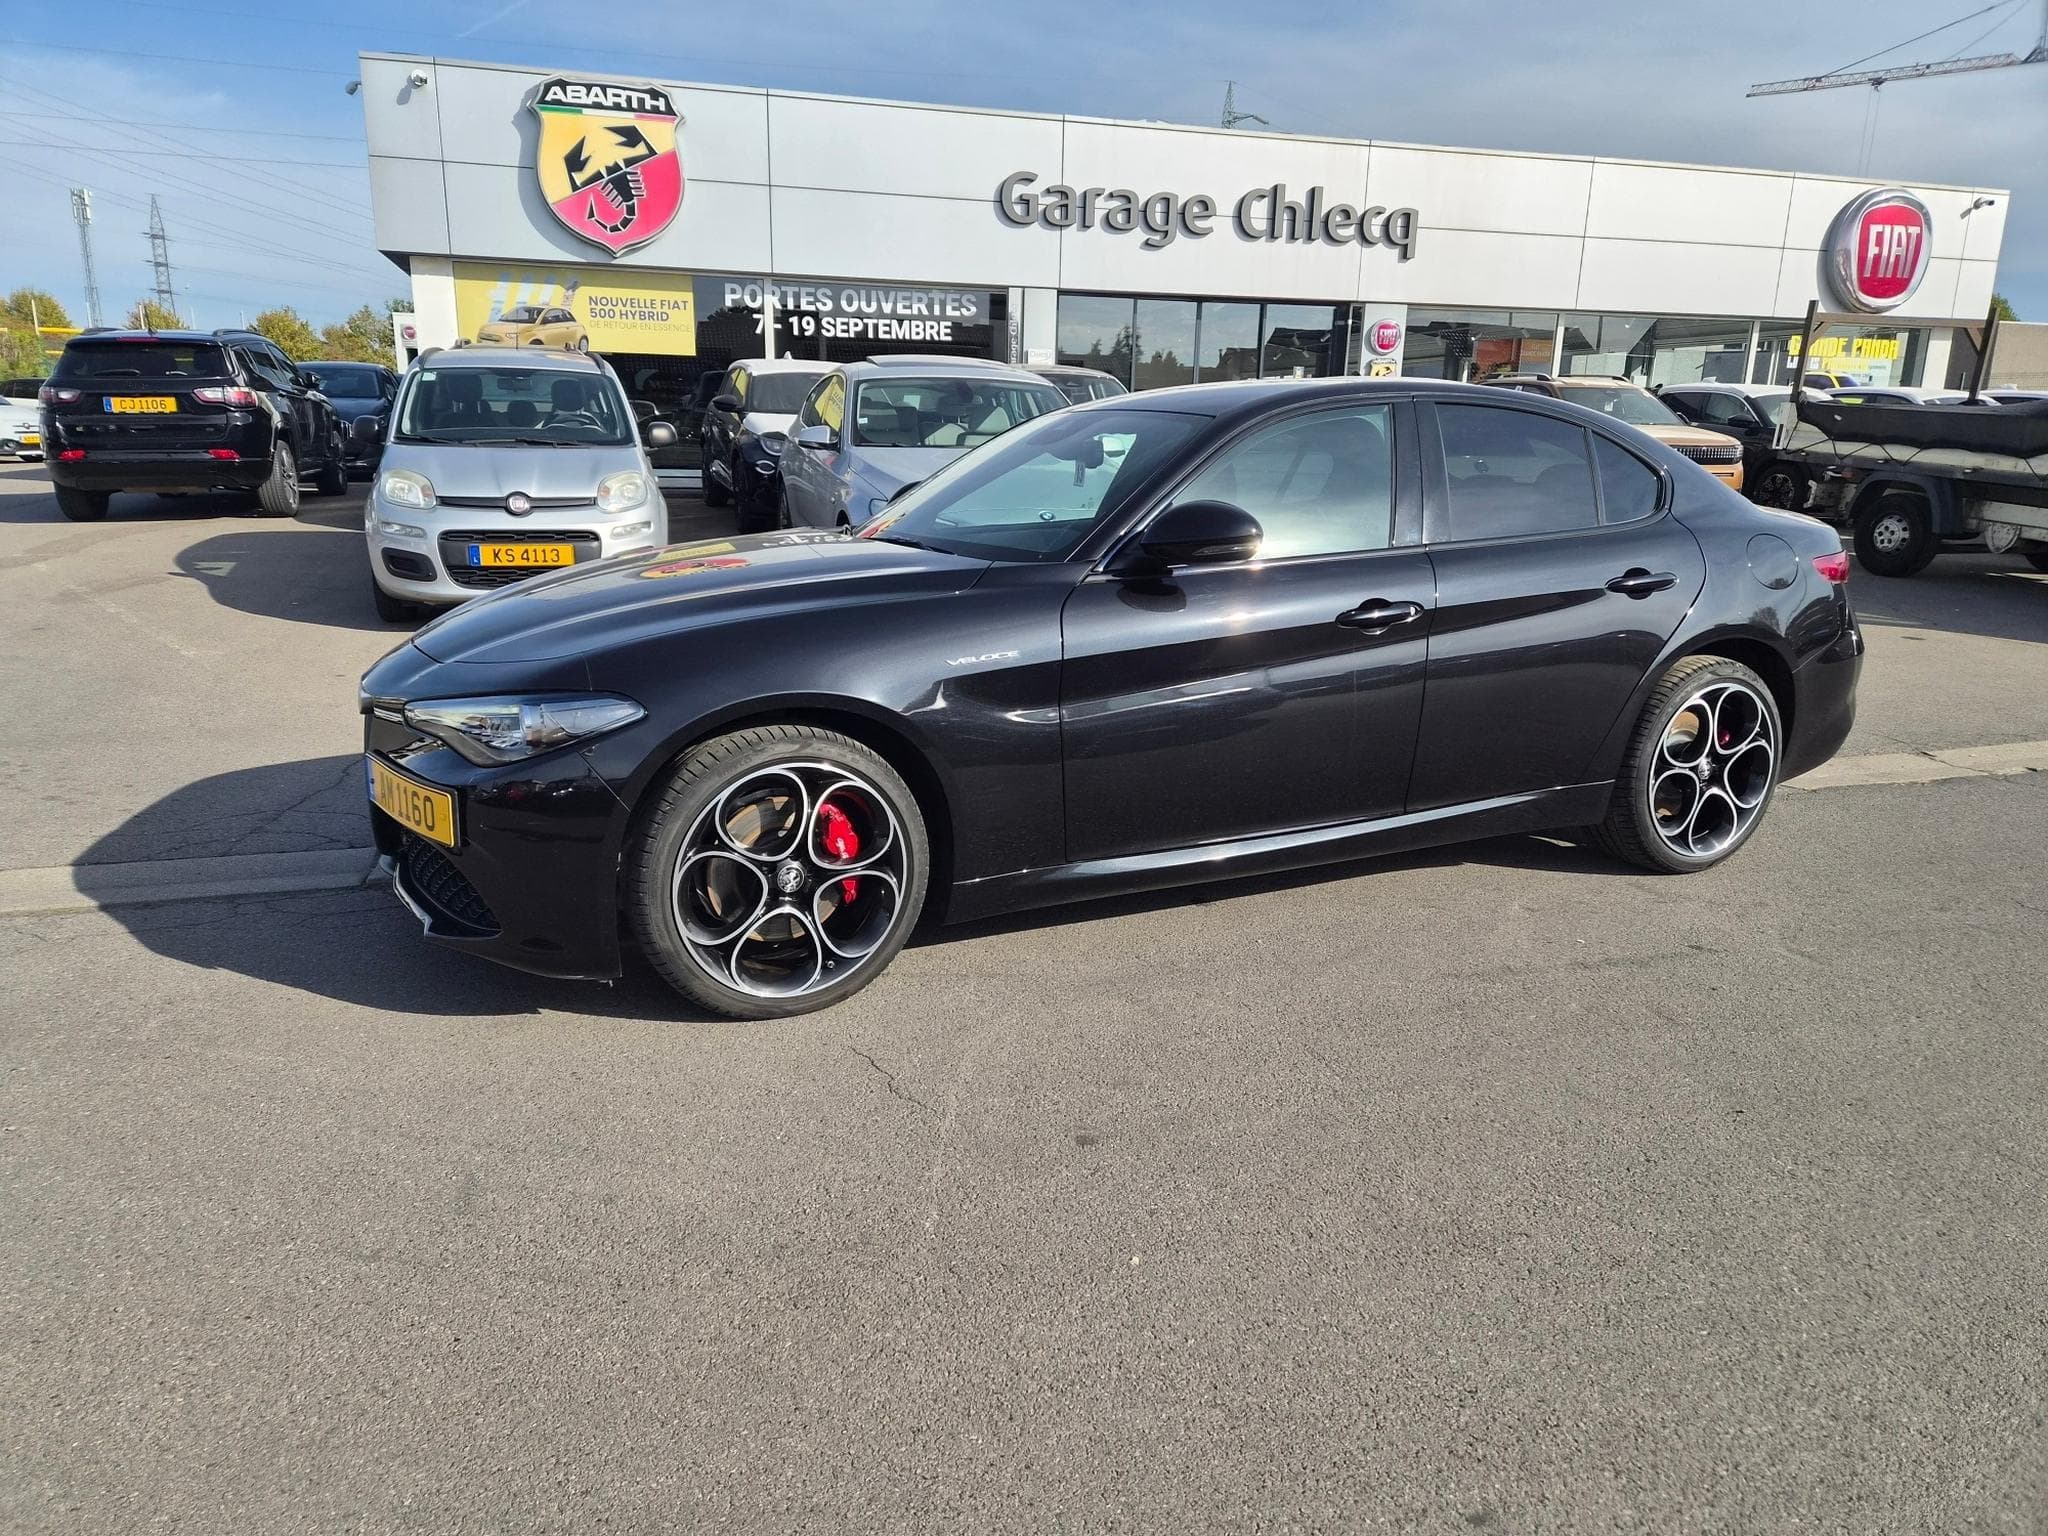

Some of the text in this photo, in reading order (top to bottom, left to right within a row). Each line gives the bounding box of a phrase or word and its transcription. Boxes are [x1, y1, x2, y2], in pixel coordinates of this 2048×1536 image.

[544, 85, 666, 111] ABARTH
[995, 170, 1419, 262] Garage Chlecq
[1863, 223, 1921, 279] FIAT
[588, 296, 688, 310] NOUVELLE FIAT
[724, 283, 977, 316] PORTES OUVERTES
[590, 308, 669, 321] 500 HYBRID
[603, 320, 638, 331] RETOUR
[653, 324, 691, 333] ESSENCE
[788, 316, 815, 337] 19
[820, 318, 953, 341] SEPTEMBRE
[493, 549, 560, 563] KS 4113
